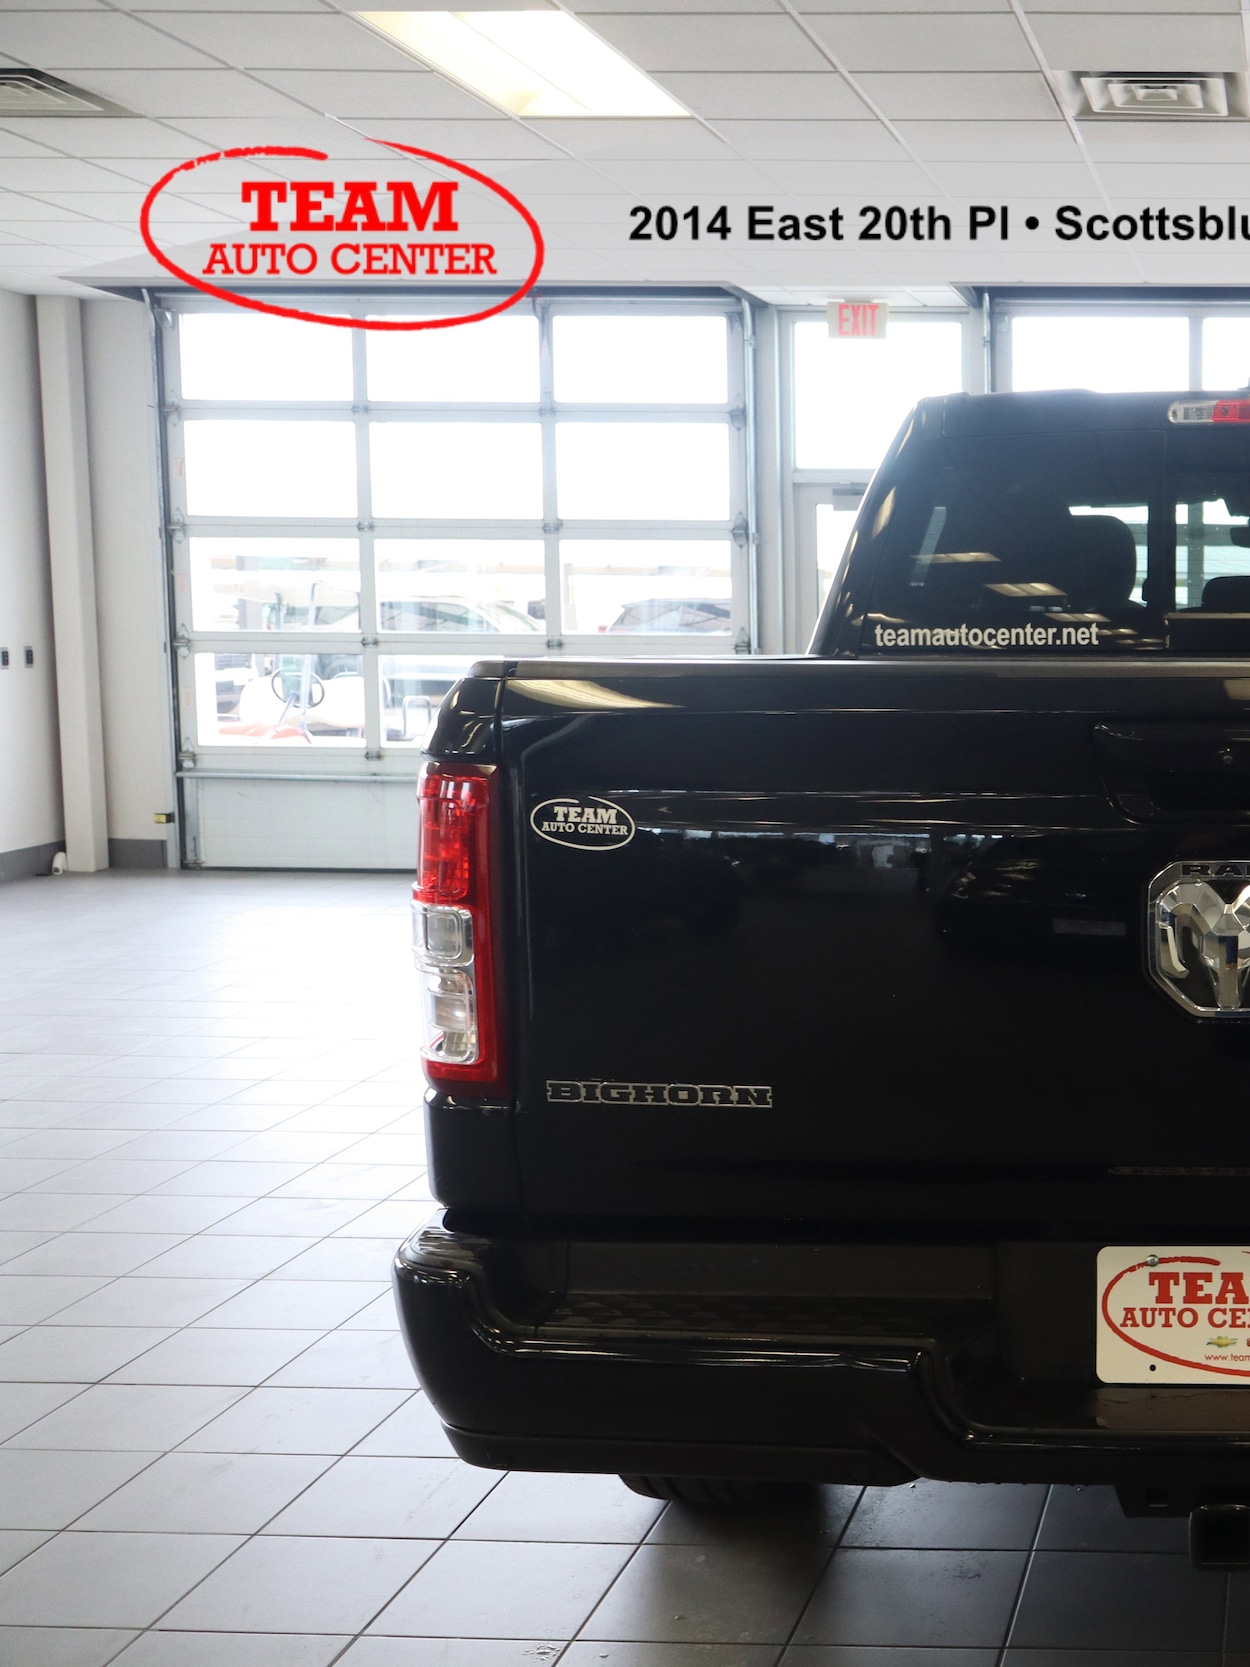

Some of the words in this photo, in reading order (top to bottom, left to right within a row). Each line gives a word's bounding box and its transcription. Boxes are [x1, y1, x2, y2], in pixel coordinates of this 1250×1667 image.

[837, 304, 880, 337] EXIT
[874, 622, 1099, 647] teamautocenter.net
[553, 806, 618, 825] TEAM
[541, 821, 576, 833] AUTO
[577, 822, 629, 836] CENTER
[546, 1079, 773, 1109] BIGHORN
[1119, 1307, 1199, 1328] AUTO
